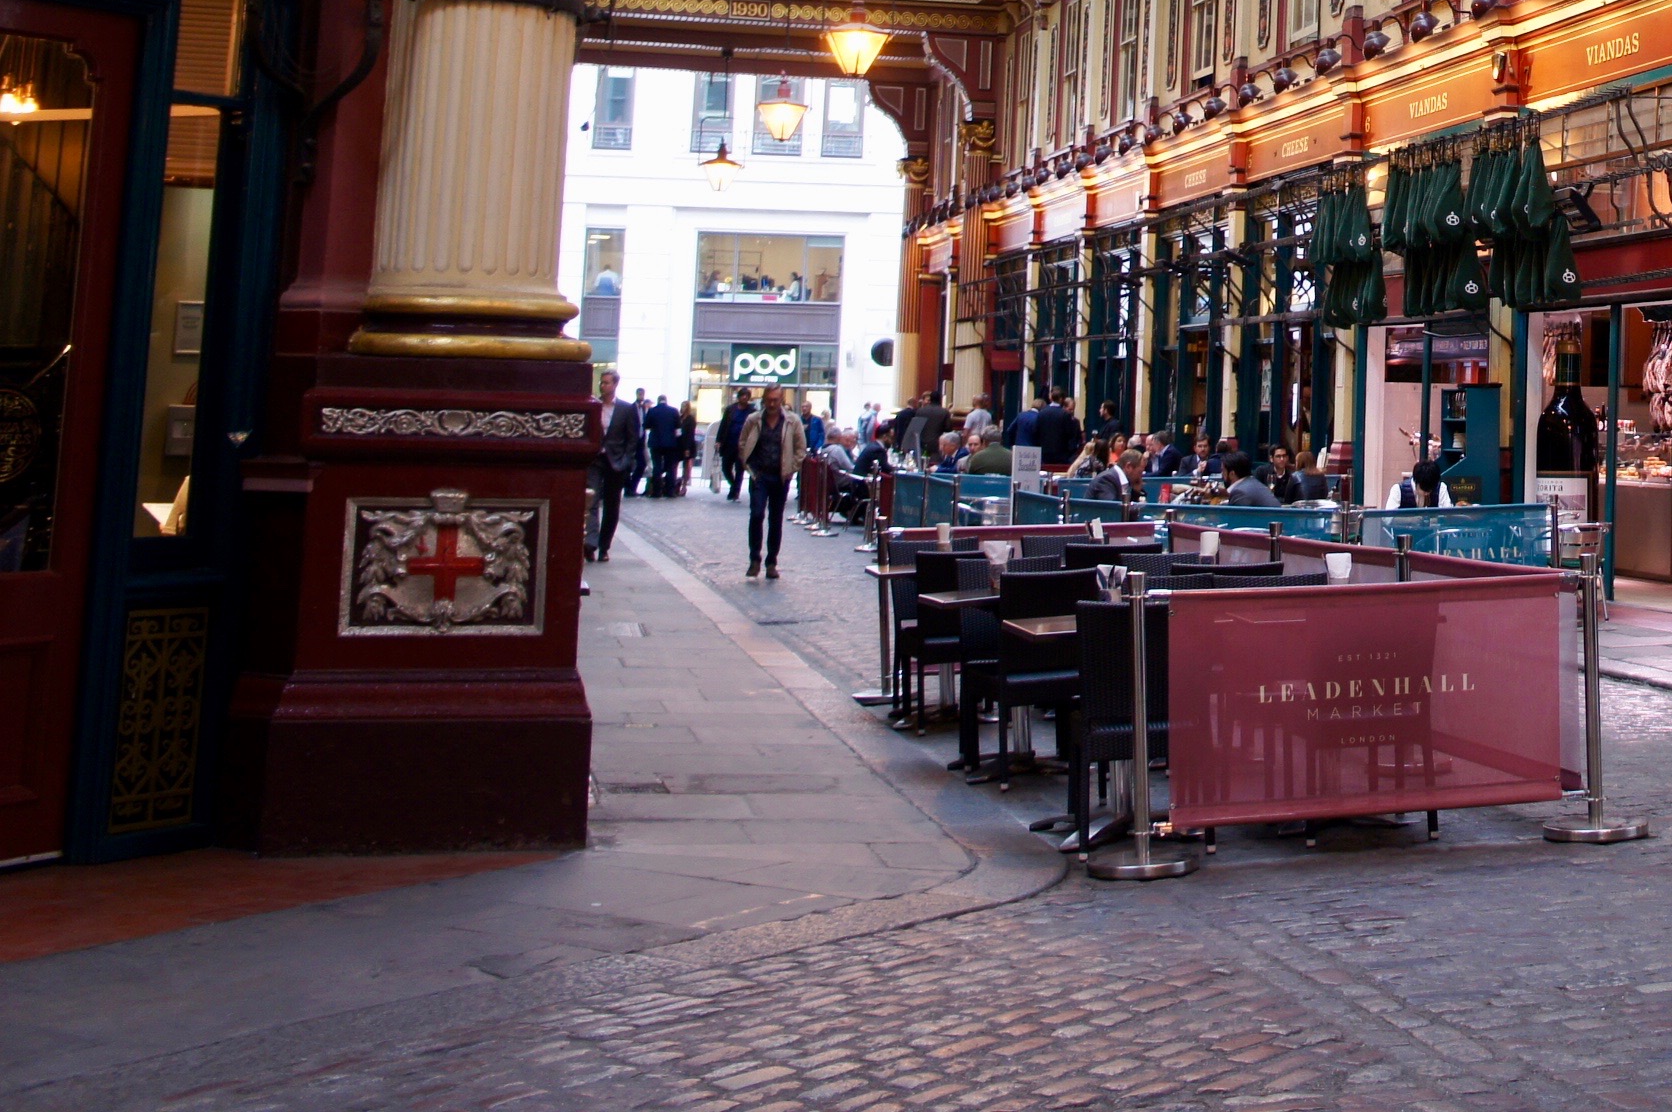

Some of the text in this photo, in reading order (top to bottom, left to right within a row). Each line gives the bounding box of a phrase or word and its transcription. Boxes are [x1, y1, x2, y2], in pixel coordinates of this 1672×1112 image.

[731, 0, 769, 18] 1990
[1585, 32, 1640, 66] VIANDAS
[1408, 92, 1448, 120] VIANDAS
[1364, 116, 1371, 134] 6
[1281, 136, 1310, 158] CHEESE
[1184, 168, 1207, 189] CHEESE
[733, 348, 797, 381] pod
[1337, 651, 1398, 663] EST 1321
[1258, 673, 1476, 704] LEADENHALL
[1306, 701, 1424, 722] MARKET
[1340, 734, 1396, 745] LONDON
